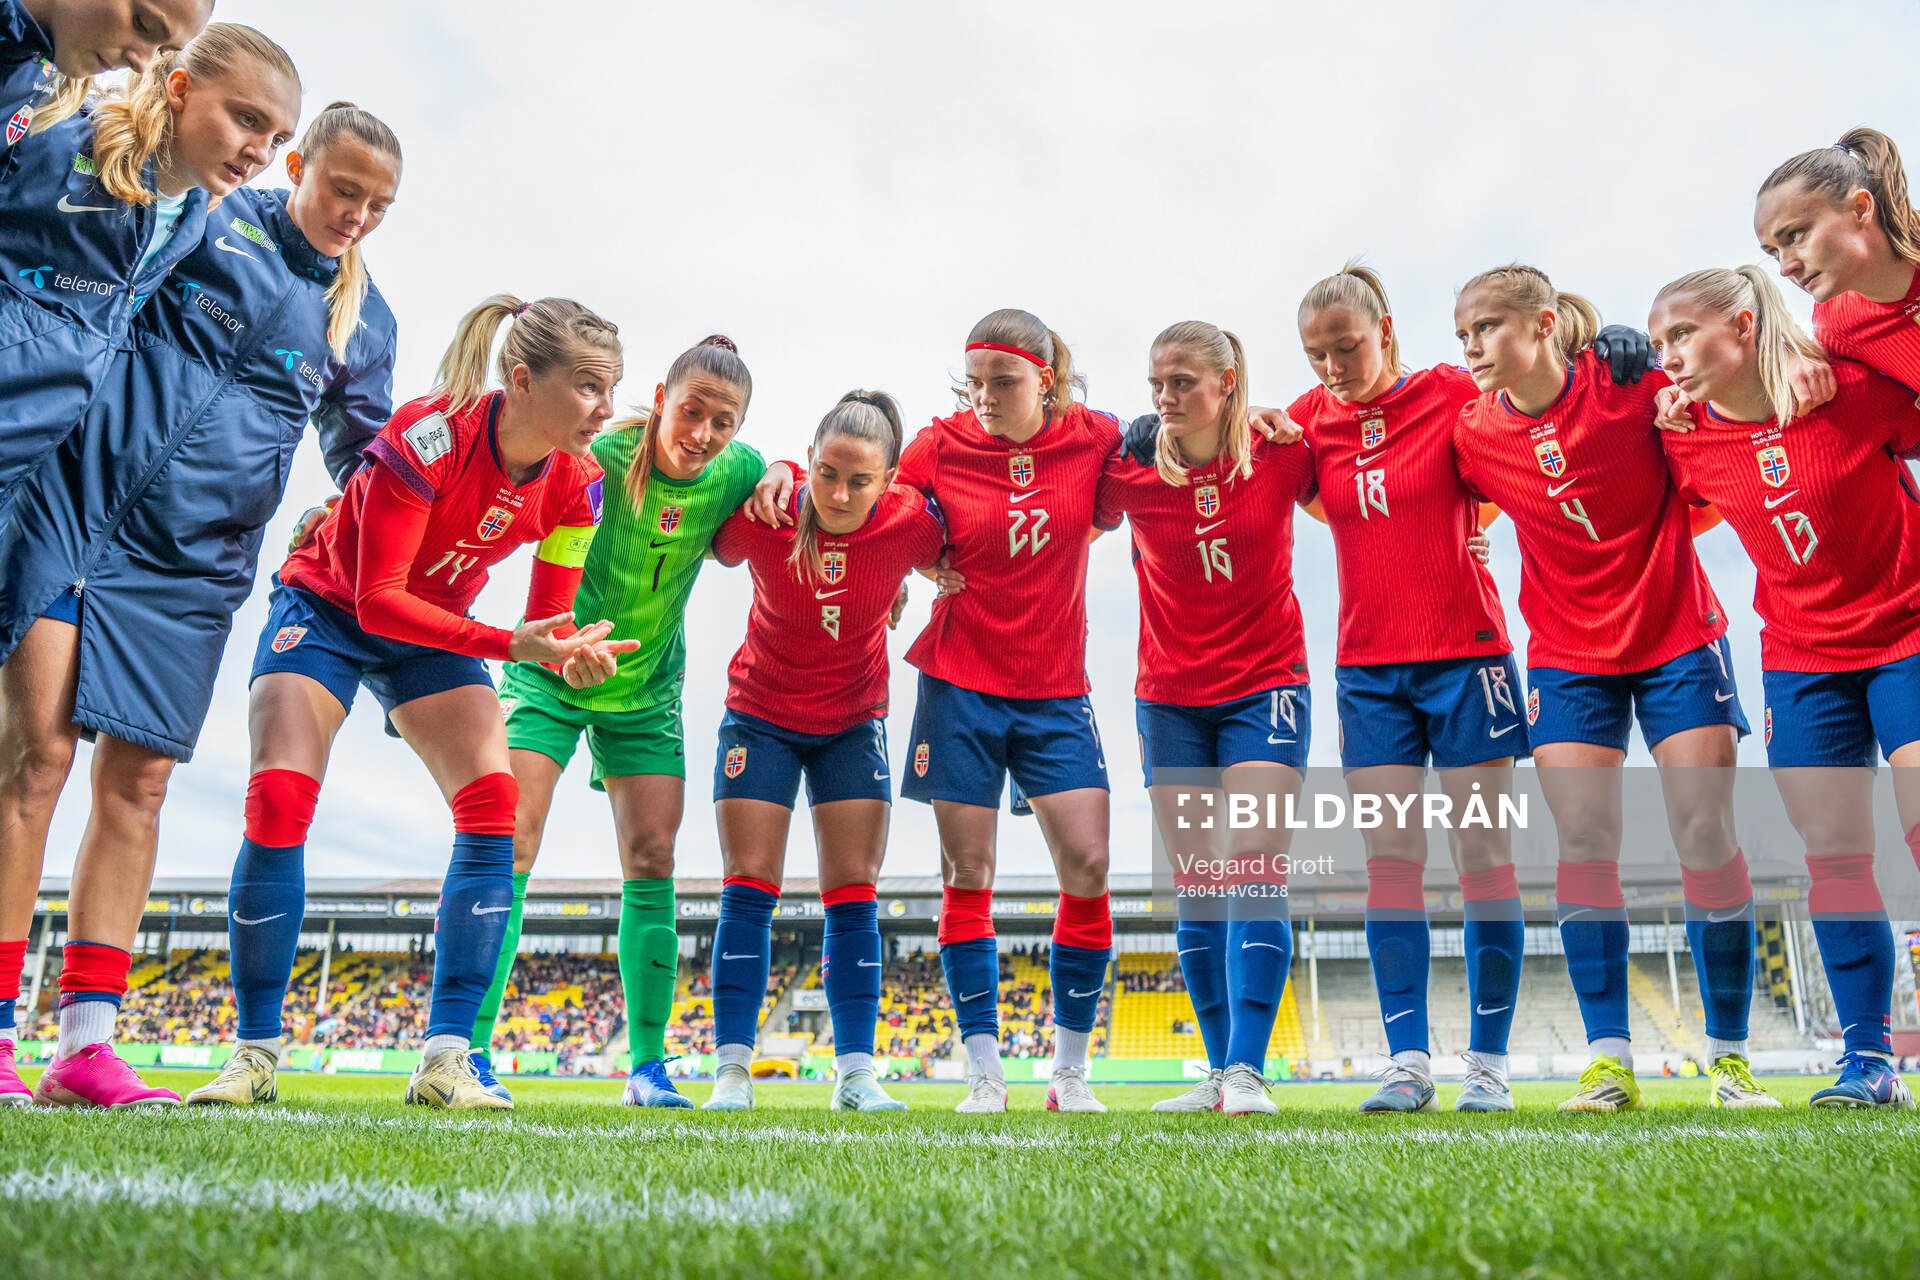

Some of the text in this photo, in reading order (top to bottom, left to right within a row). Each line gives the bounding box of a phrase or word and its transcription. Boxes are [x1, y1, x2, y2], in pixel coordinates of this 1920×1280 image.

[231, 217, 265, 245] KIWI
[54, 274, 116, 296] telenor
[194, 293, 245, 333] telenor
[1353, 468, 1390, 520] 18
[1008, 510, 1050, 558] 22
[1559, 498, 1600, 542] 4
[1771, 510, 1819, 566] 13
[424, 551, 480, 586] 14
[652, 554, 666, 592] 1
[1196, 538, 1232, 583] 16
[822, 606, 840, 641] 8
[1270, 690, 1298, 733] 16
[1477, 666, 1517, 717] 18
